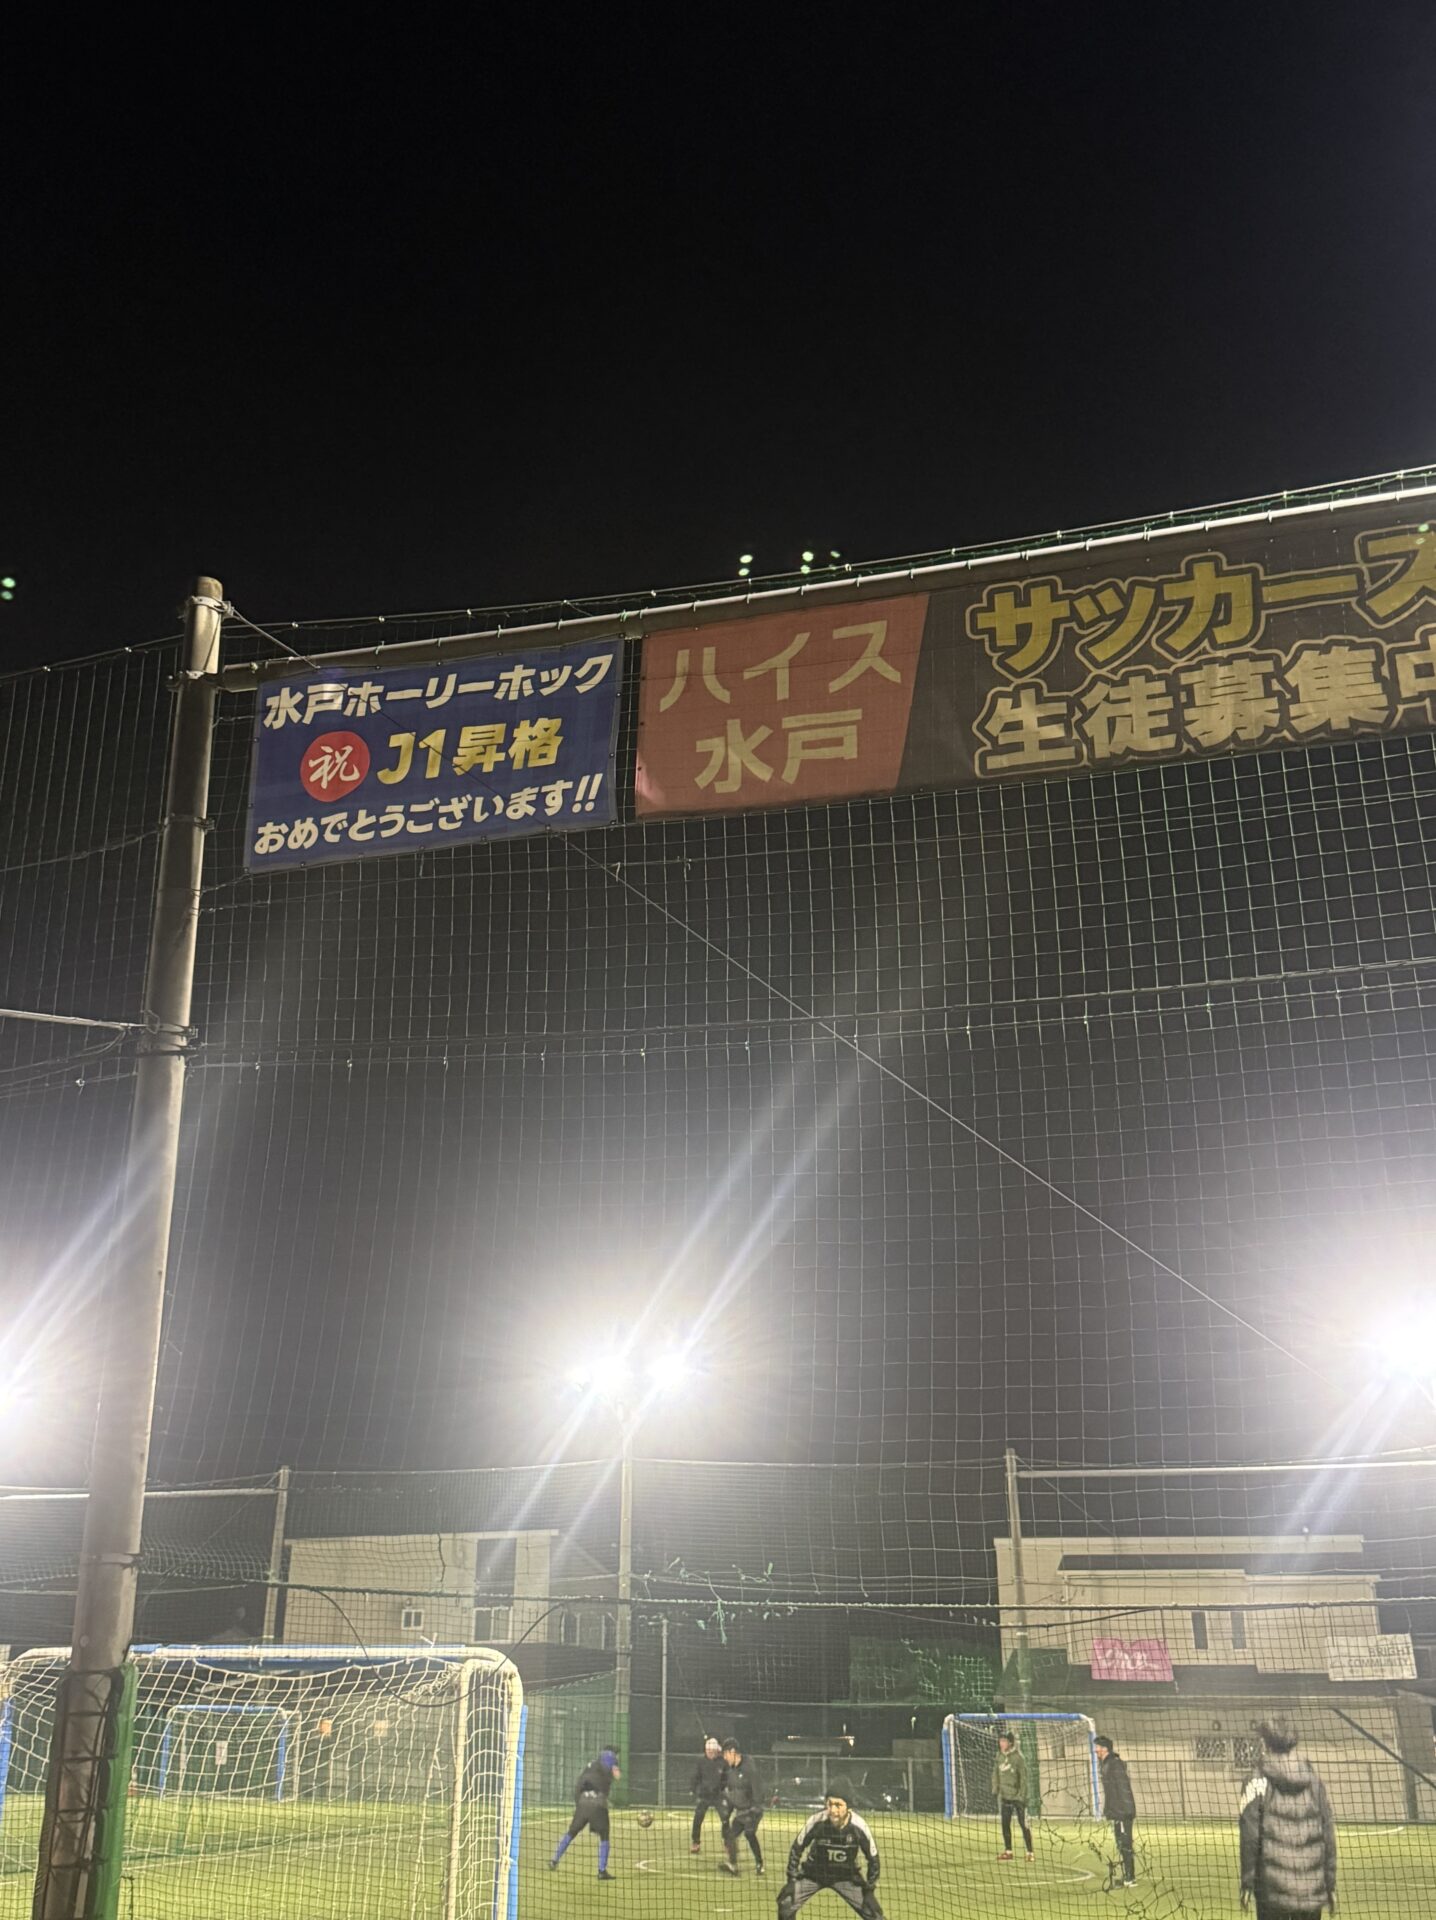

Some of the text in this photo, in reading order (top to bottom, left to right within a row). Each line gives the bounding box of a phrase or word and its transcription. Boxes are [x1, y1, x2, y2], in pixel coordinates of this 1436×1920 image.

[263, 653, 614, 730] 水戸ホーリーホック
[659, 619, 901, 713] ハイス
[308, 745, 360, 789] 祝
[694, 708, 863, 793] 水戸
[1369, 1645, 1411, 1657] BRIGHT
